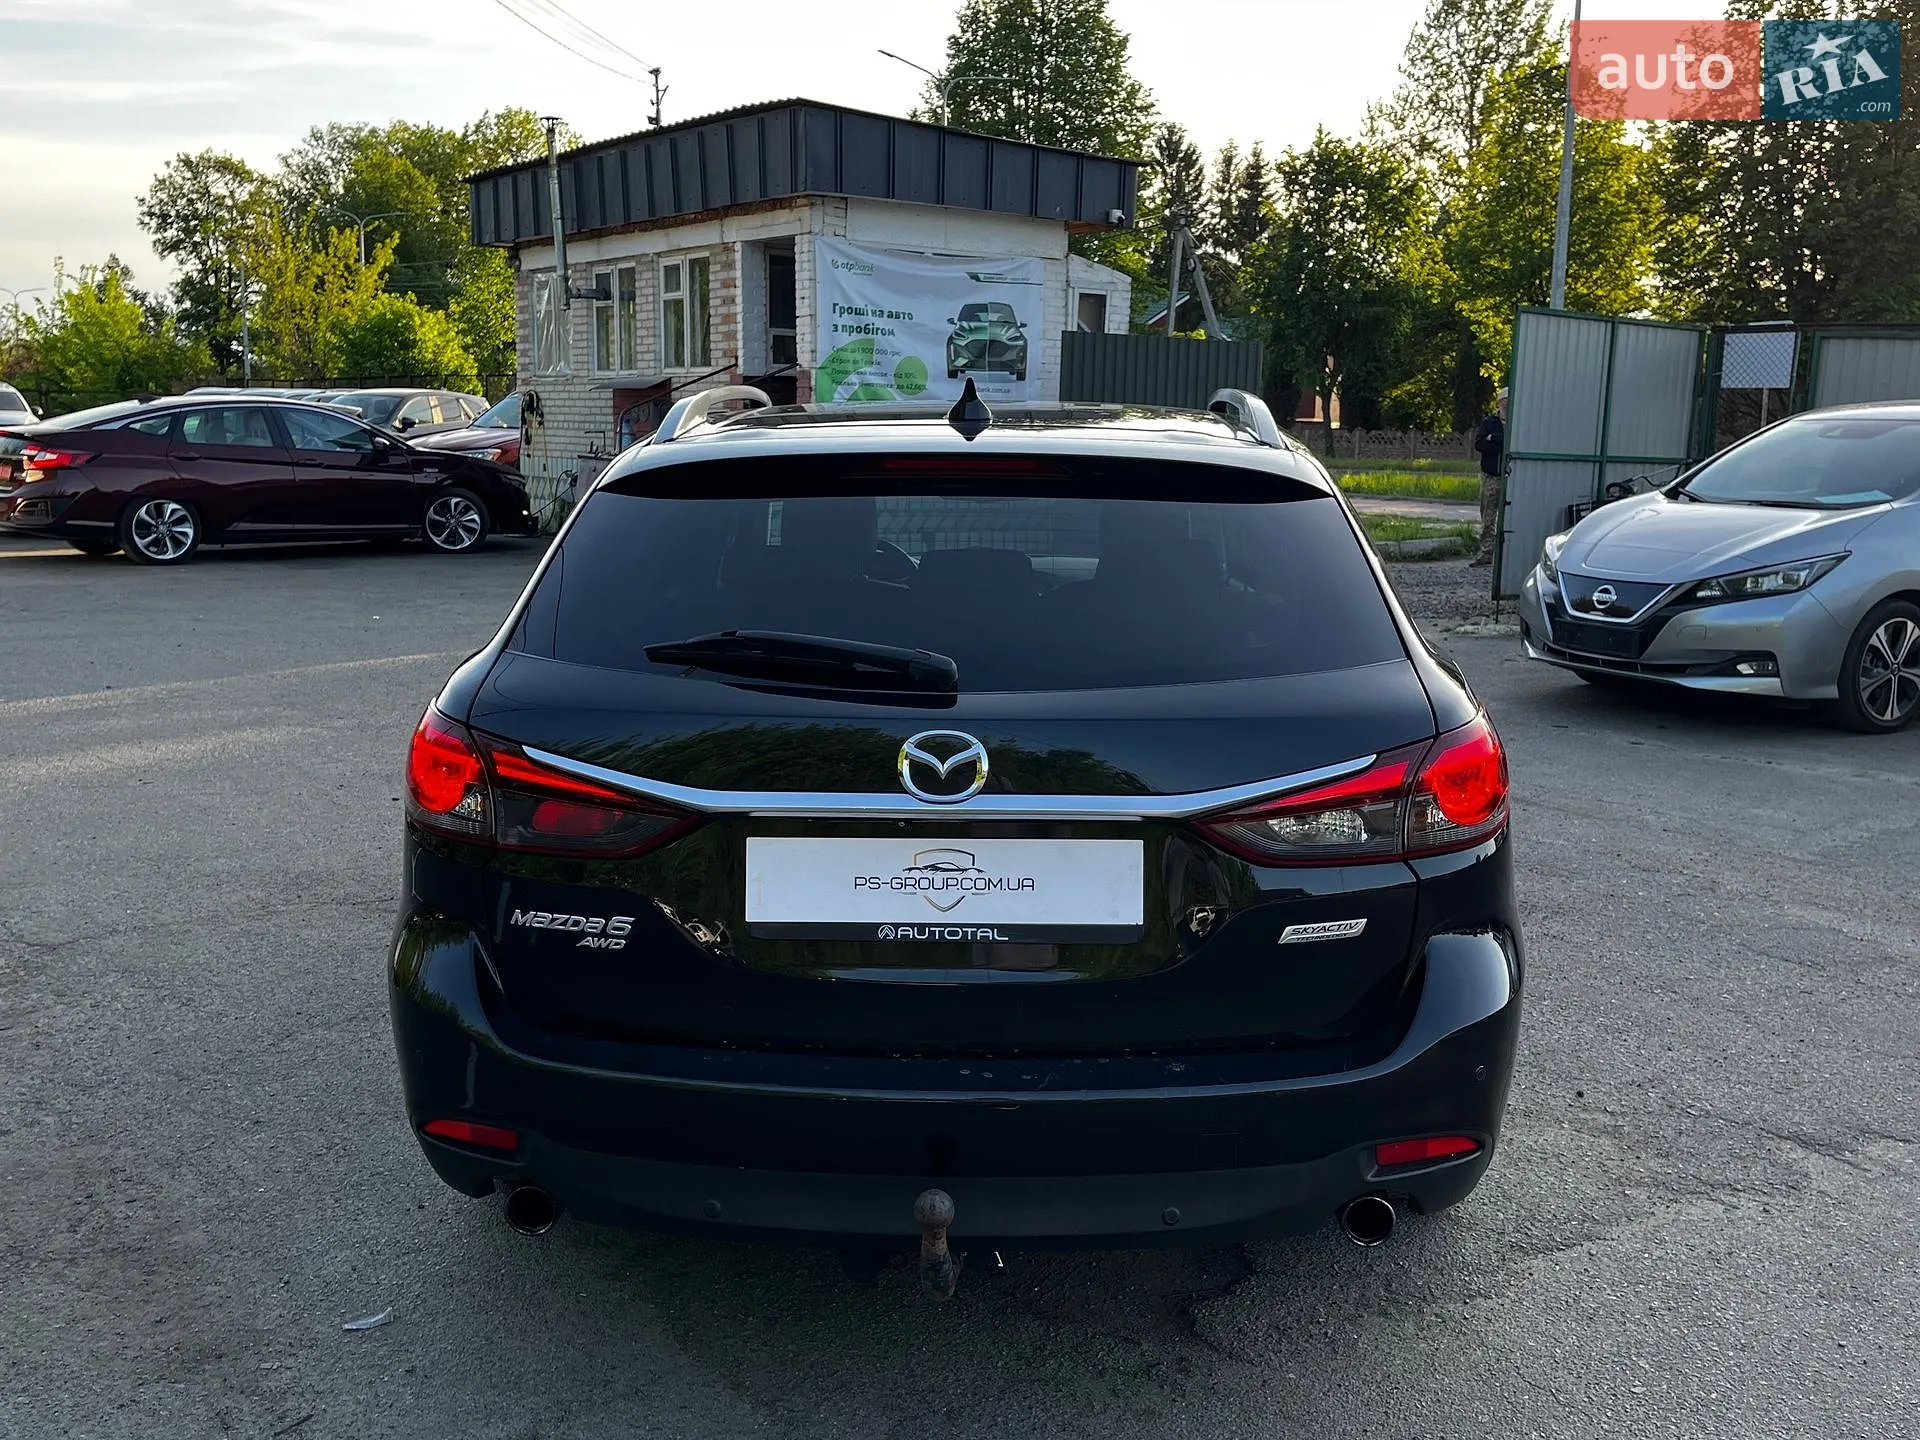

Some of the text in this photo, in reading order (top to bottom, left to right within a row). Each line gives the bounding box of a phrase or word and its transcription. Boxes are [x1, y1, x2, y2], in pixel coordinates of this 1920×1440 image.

[832, 303, 914, 320] Гроші на авто
[832, 323, 896, 337] з пробігом
[854, 876, 1035, 892] PS-GROUP.COM.UA
[897, 926, 1009, 941] AUTOTAL
[1291, 922, 1360, 936] SKYACTIV
[576, 936, 627, 949] AWD
